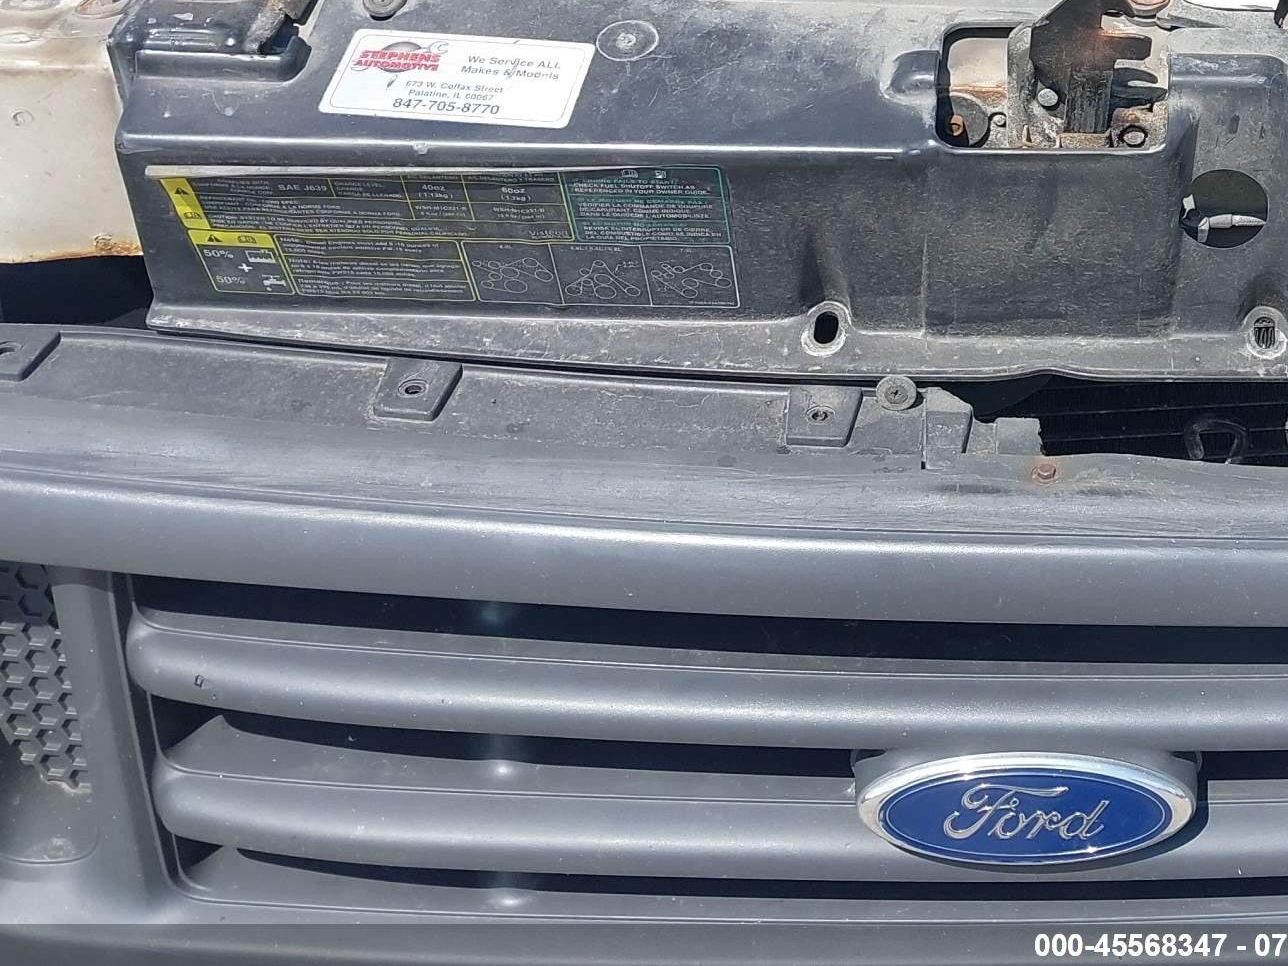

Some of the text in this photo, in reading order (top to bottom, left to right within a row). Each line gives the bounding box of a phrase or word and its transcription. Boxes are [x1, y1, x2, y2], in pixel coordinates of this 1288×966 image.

[359, 49, 442, 63] STEPHENS
[468, 55, 485, 63] We
[537, 61, 561, 69] ALL
[352, 59, 439, 72] AUTOMOTIVE
[461, 65, 499, 75] Makes
[474, 85, 504, 93] Street
[392, 98, 499, 115] 847-705-8770
[303, 184, 328, 192] J639
[204, 249, 234, 259] 50%
[943, 783, 1109, 840] Ford
